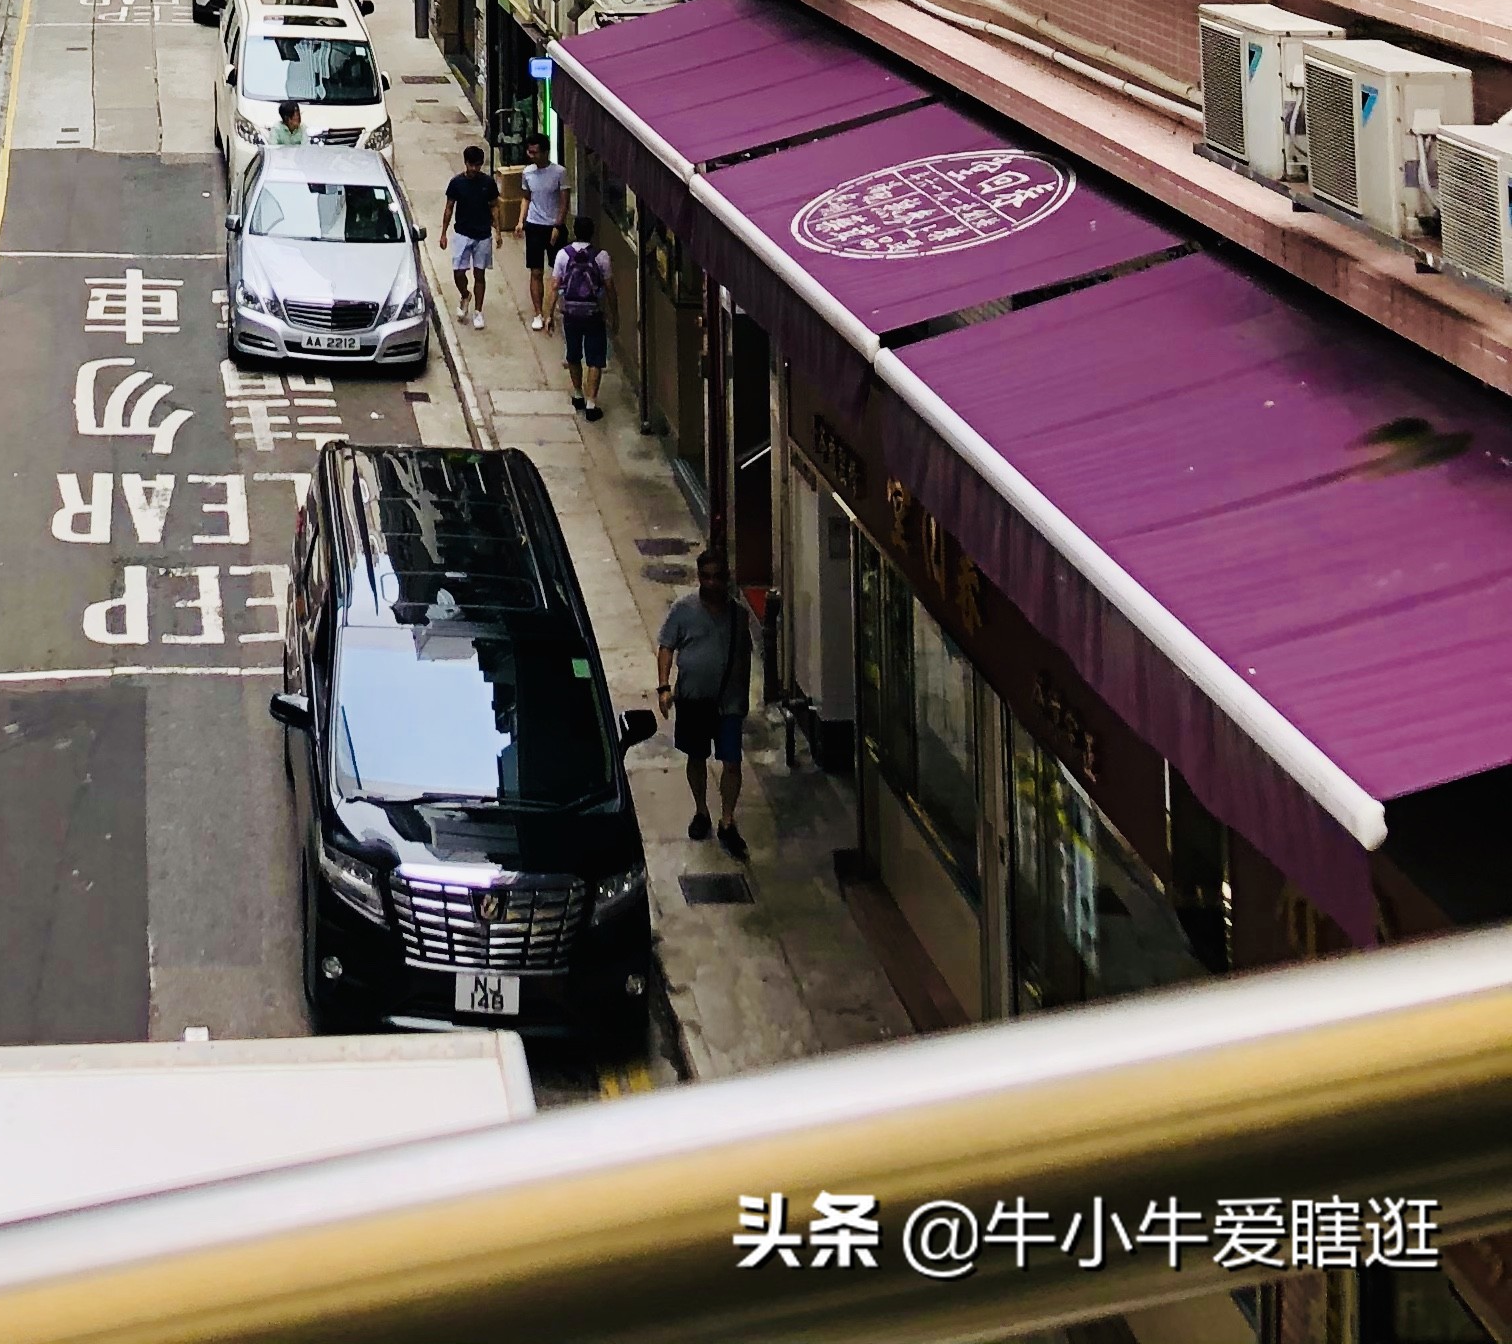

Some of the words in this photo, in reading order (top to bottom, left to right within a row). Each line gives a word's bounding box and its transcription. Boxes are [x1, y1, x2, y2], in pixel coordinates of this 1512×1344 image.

[306, 336, 322, 347] AA
[327, 337, 356, 349] 2212
[51, 472, 312, 545] LEAR
[83, 564, 290, 645] EEP
[474, 976, 502, 994] NJ
[471, 992, 504, 1010] 148
